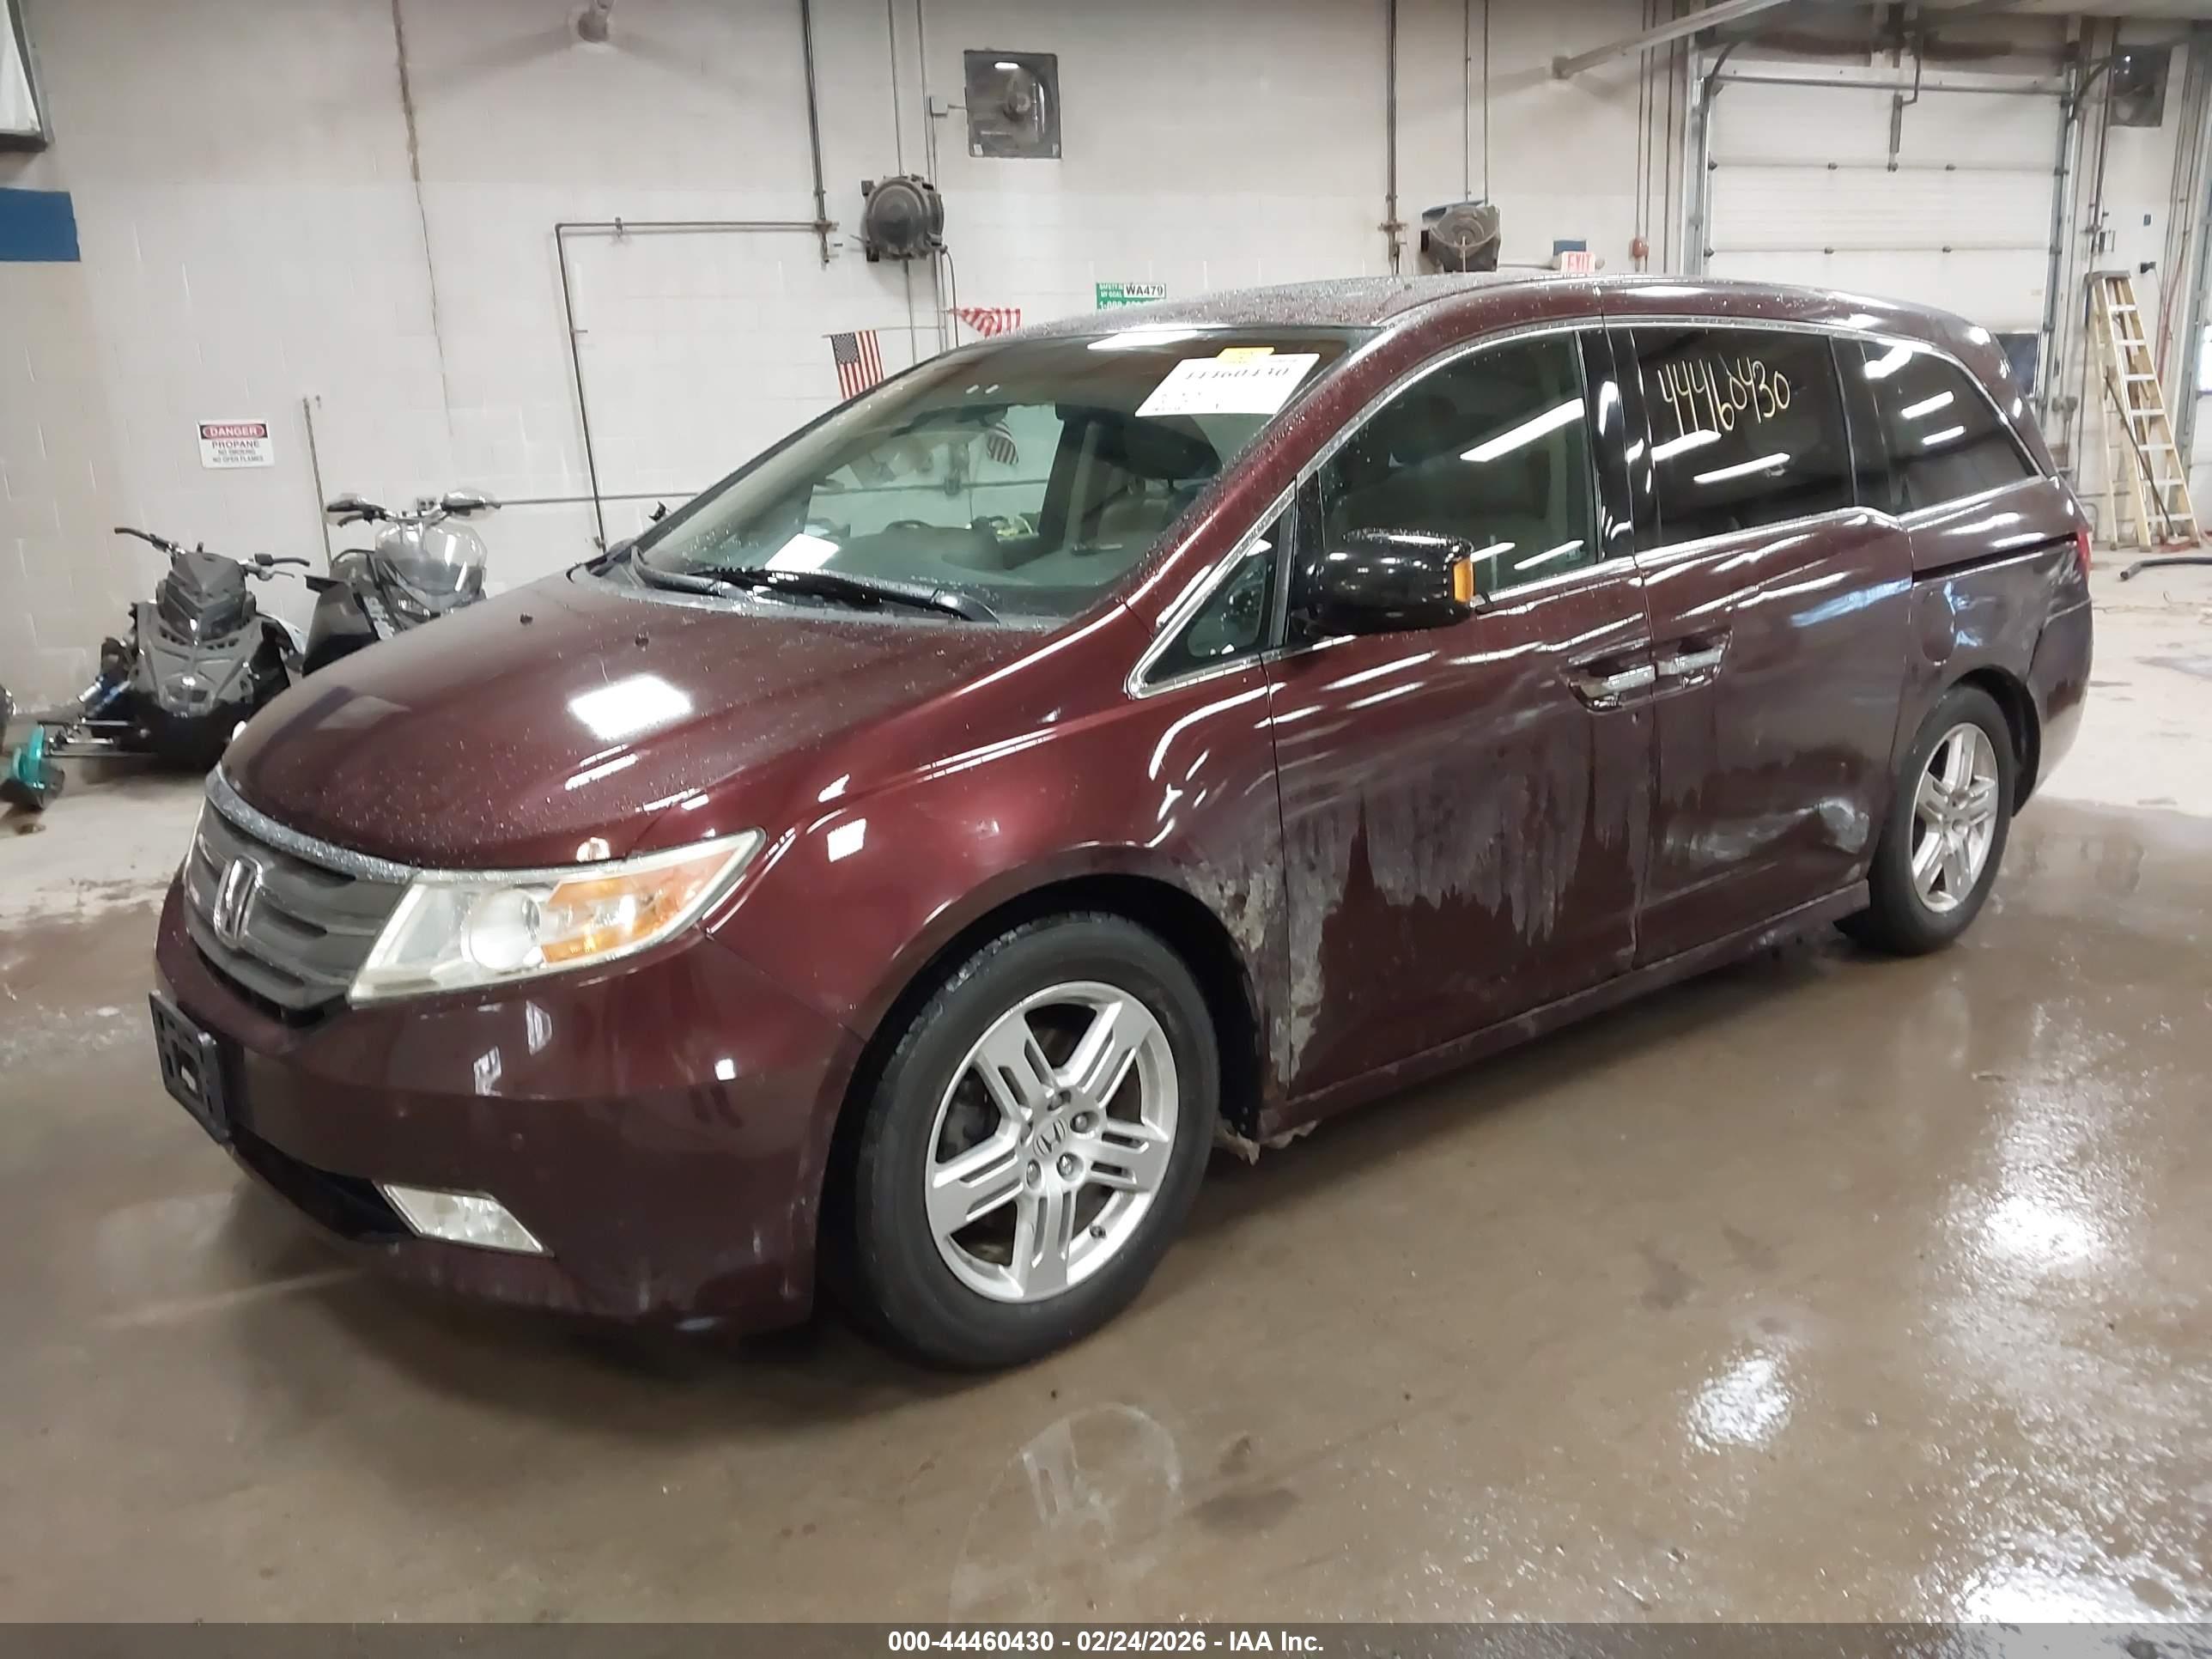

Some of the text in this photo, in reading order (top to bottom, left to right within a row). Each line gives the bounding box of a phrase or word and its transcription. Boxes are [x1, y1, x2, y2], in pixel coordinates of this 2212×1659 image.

[1567, 253, 1591, 271] EXIT
[1126, 284, 1164, 296] WA479
[1657, 353, 1790, 437] 44460430
[210, 425, 258, 436] DANGER
[212, 440, 259, 448] PROPANE
